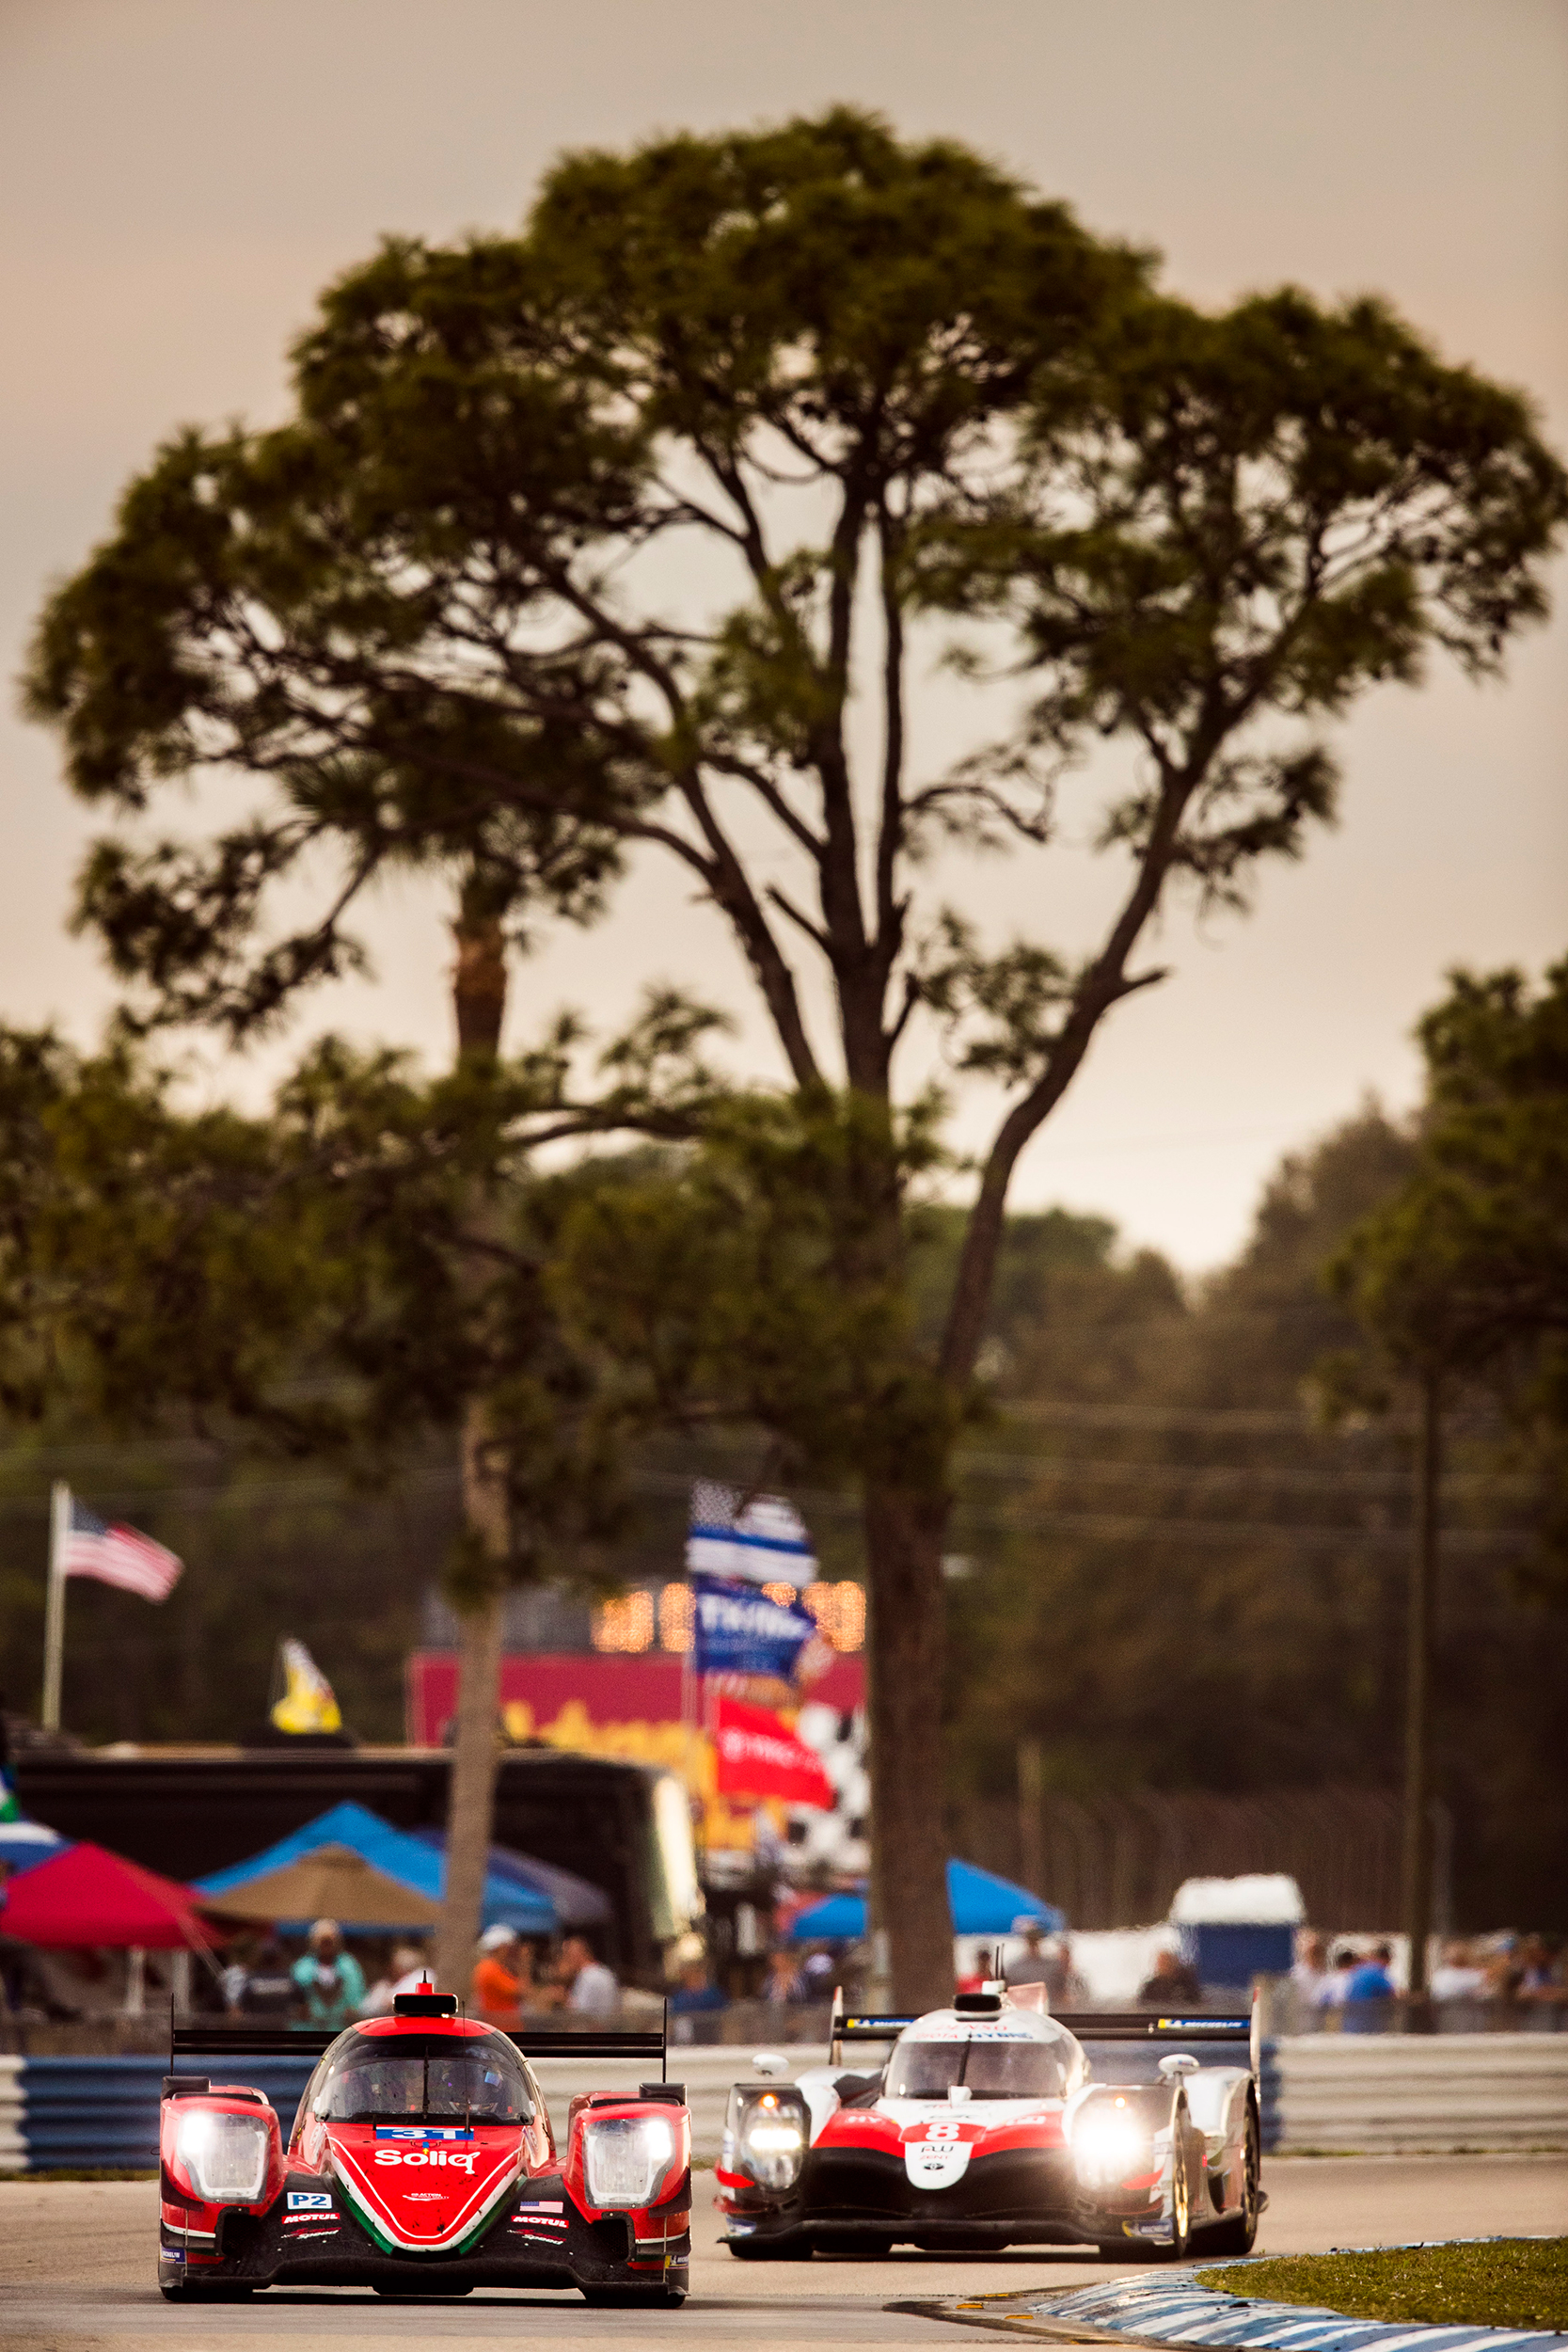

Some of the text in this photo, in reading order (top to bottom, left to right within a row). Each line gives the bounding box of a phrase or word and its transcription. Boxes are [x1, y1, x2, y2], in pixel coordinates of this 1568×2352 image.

[391, 2129, 456, 2139] 31
[925, 2122, 959, 2140] 8
[374, 2149, 481, 2174] Soliq
[293, 2194, 327, 2206] P2
[283, 2213, 339, 2224] MOTUL
[513, 2216, 567, 2228] MOTUL
